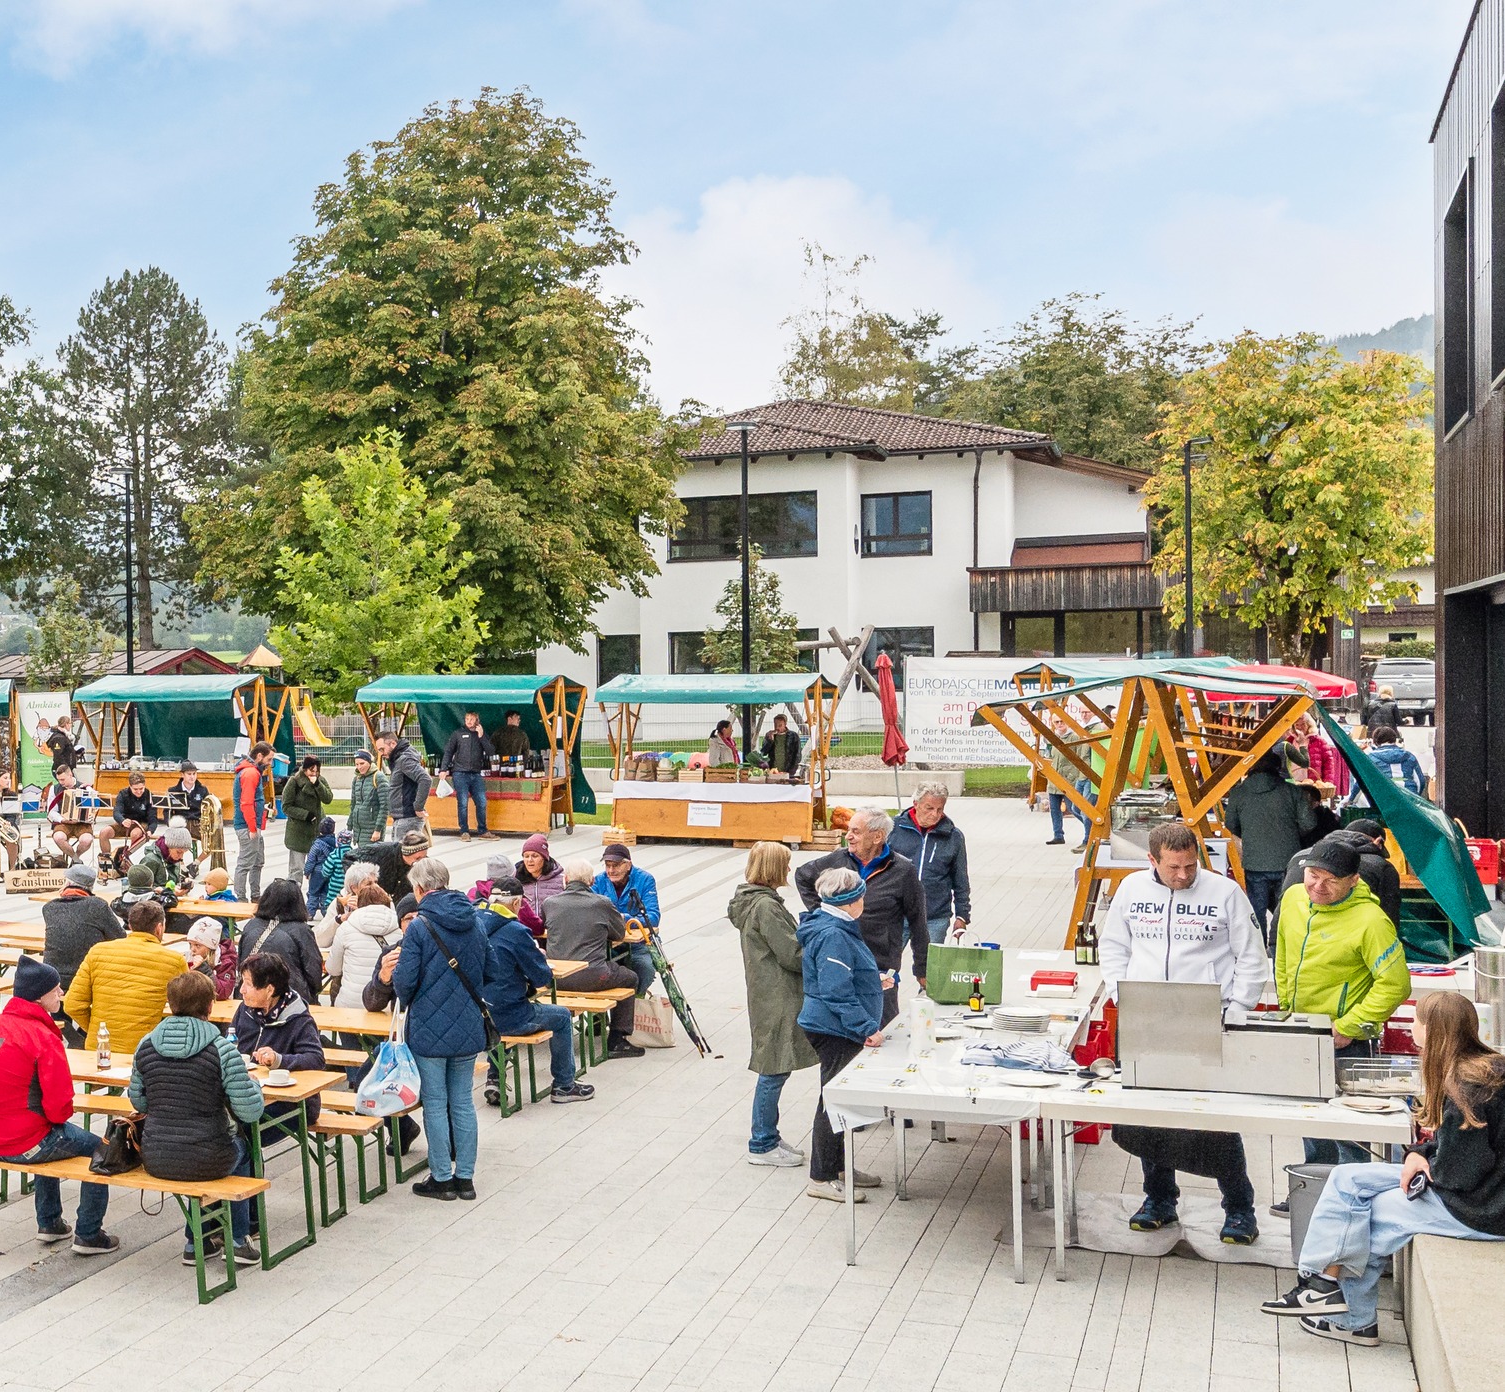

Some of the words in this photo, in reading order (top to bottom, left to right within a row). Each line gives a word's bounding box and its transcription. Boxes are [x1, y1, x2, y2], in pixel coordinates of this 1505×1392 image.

[941, 689, 953, 697] bis
[970, 690, 1016, 699] September
[25, 701, 63, 710] Almkäse
[943, 703, 964, 712] am
[938, 715, 963, 725] und
[910, 727, 920, 735] in
[922, 727, 938, 736] der
[940, 727, 1002, 739] Kaiserbergs
[922, 737, 943, 745] Mehr
[977, 738, 1007, 746] Internet
[914, 745, 957, 753] Mitmachen
[926, 753, 950, 761] Teilen
[1129, 902, 1165, 915] CREW
[1176, 903, 1218, 918] BLUE
[1135, 932, 1164, 940] GREAT
[1173, 933, 1214, 941] OCEANS
